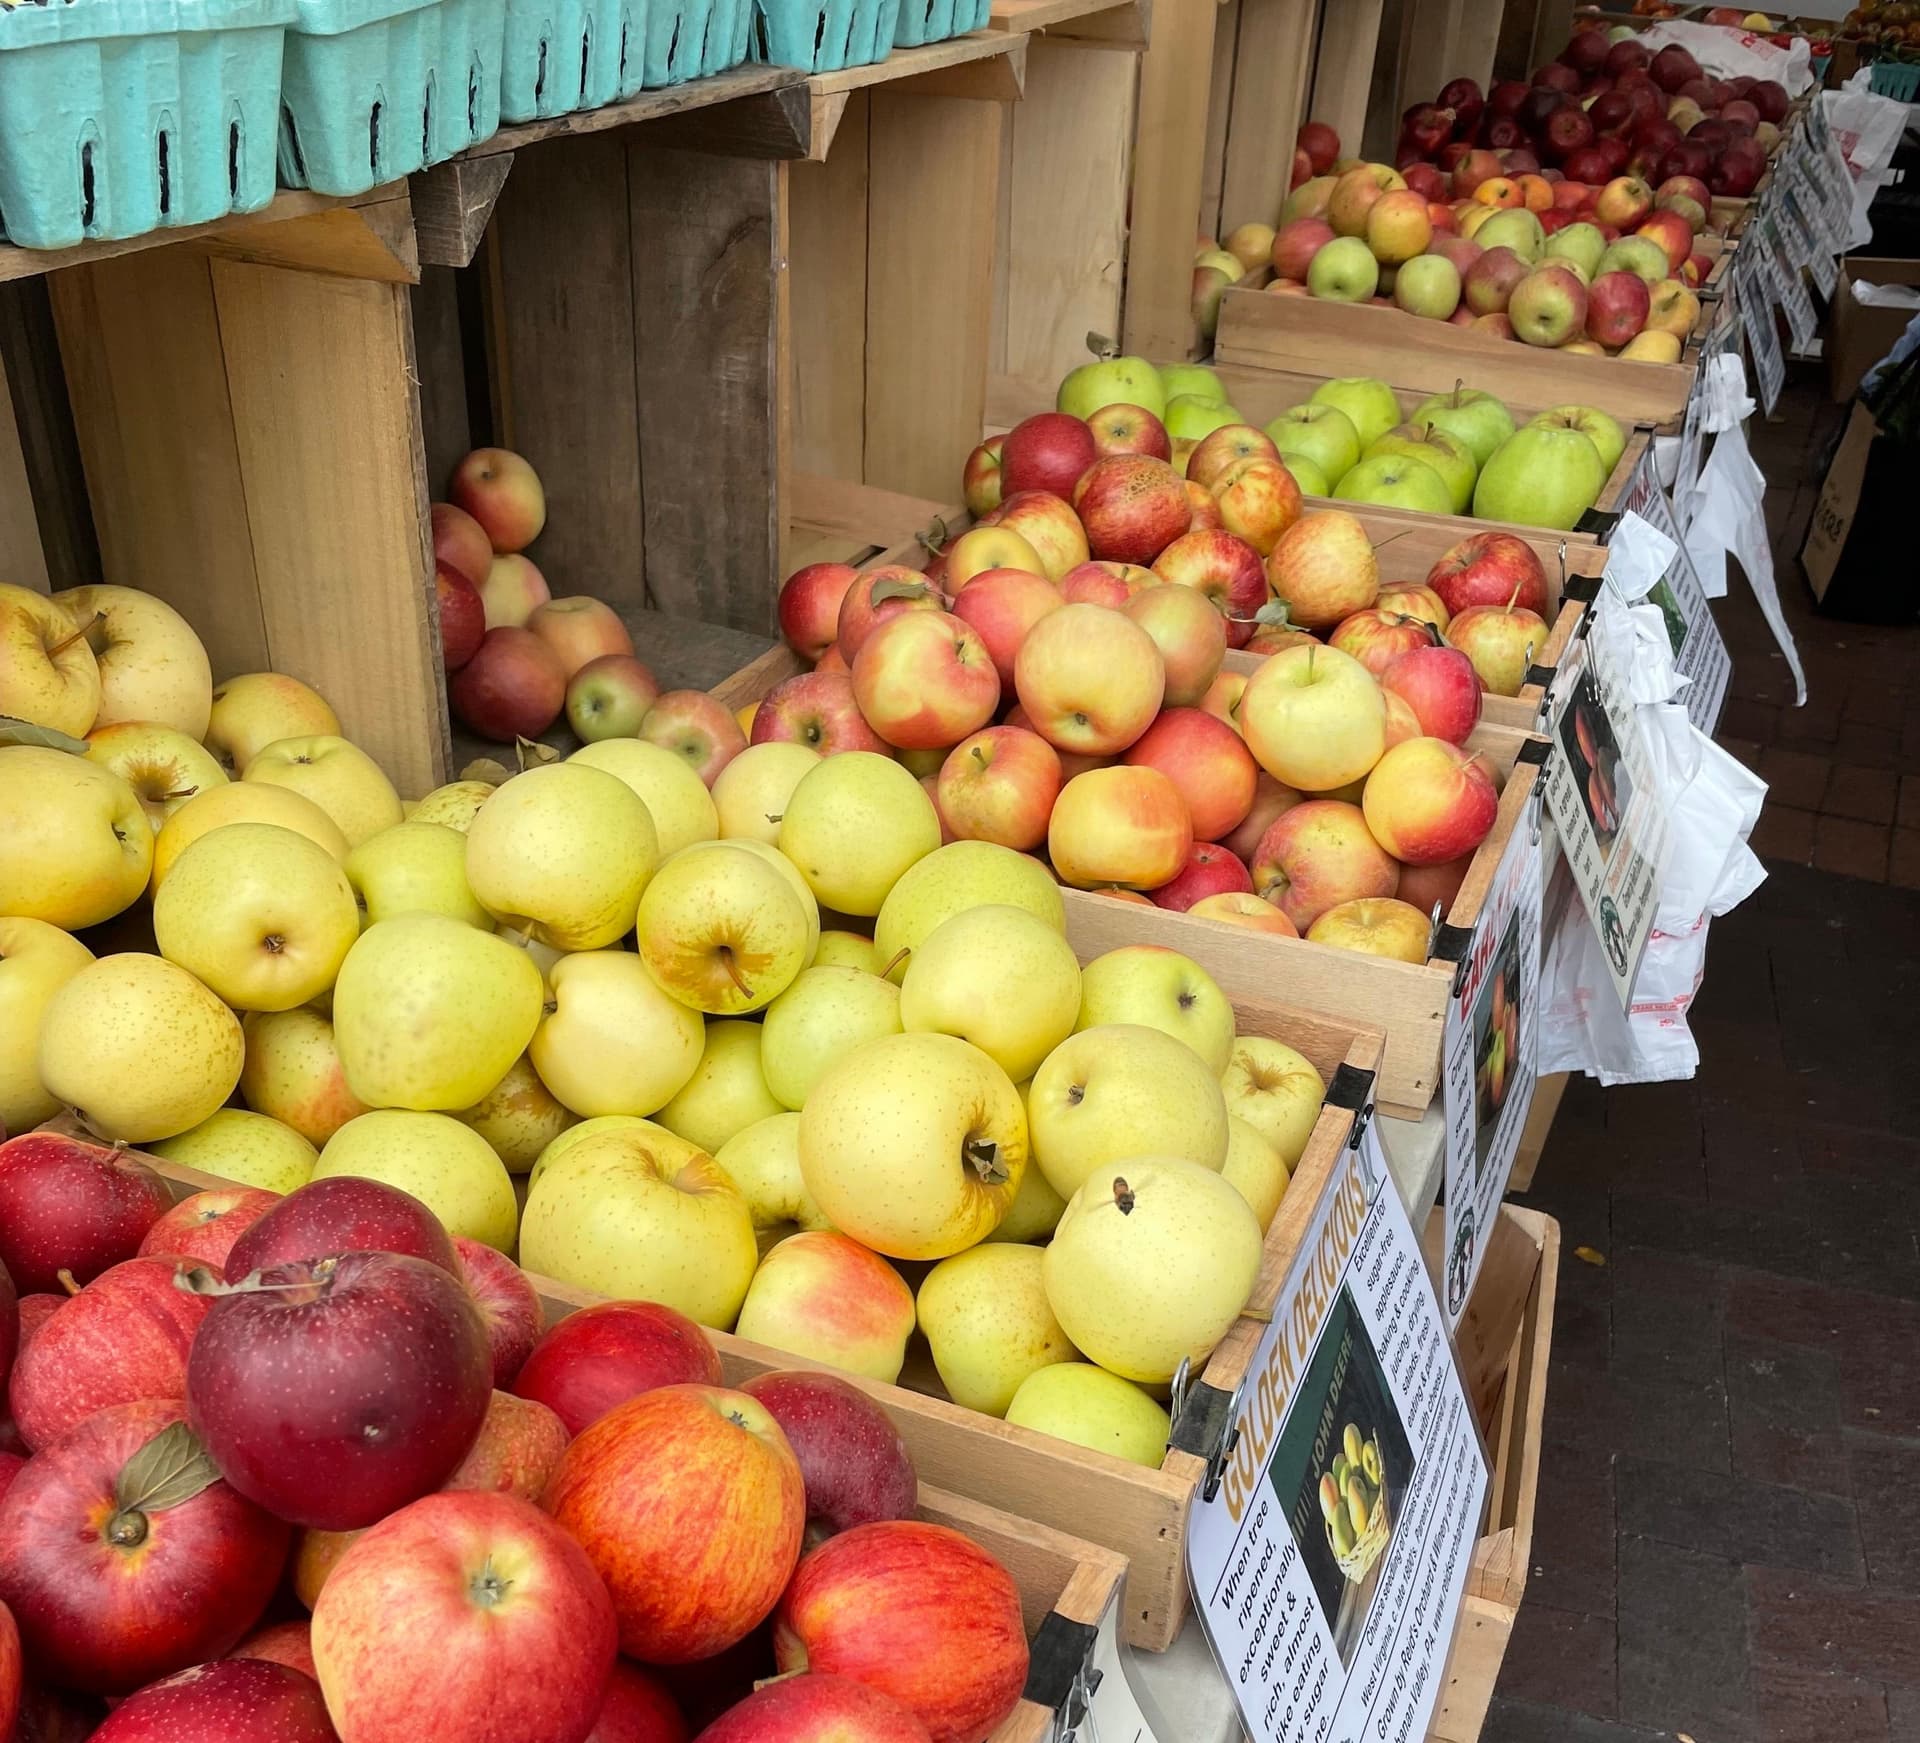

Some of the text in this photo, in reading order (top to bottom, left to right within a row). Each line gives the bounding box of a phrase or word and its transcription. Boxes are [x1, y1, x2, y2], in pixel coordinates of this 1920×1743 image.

[1451, 1029, 1472, 1086] Crunchy
[1458, 1066, 1468, 1102] and
[1455, 1090, 1471, 1139] sweet
[1458, 1128, 1469, 1160] with
[1451, 1137, 1475, 1206] excellent
[1353, 1198, 1387, 1273] Excellent for
[1366, 1228, 1395, 1292] sugar-free
[1375, 1250, 1407, 1322] applesauce,
[1377, 1258, 1421, 1363] baking & cooking,
[1222, 1153, 1366, 1523] GOLDEN DELICIOUS
[1390, 1290, 1426, 1383] juicing, drying,
[1402, 1315, 1431, 1396] salads, fresh
[1313, 1327, 1354, 1478] JOHN DEERE
[1407, 1330, 1441, 1429] eating & pairing
[1417, 1366, 1444, 1441] with cheese
[1413, 1458, 1428, 1499] Golden
[1430, 1463, 1442, 1496] many
[1451, 1474, 1459, 1498] our
[1454, 1444, 1467, 1480] Farm
[1400, 1496, 1417, 1538] Grimes
[1414, 1502, 1428, 1543] Parent
[1426, 1492, 1433, 1508] to
[1446, 1496, 1455, 1517] on
[1221, 1500, 1269, 1611] When tree
[1399, 1532, 1406, 1550] of
[1432, 1511, 1450, 1559] Winery
[1238, 1538, 1276, 1630] ripened,
[1383, 1550, 1403, 1601] seedling
[1430, 1553, 1437, 1573] &
[1240, 1538, 1296, 1684] exceptionally
[1391, 1610, 1398, 1623] c.
[1394, 1583, 1405, 1610] late
[1414, 1563, 1435, 1627] Orchard
[1261, 1591, 1297, 1683] sweet &
[1366, 1597, 1385, 1647] Chance
[1264, 1596, 1315, 1732] rich, almost
[1373, 1623, 1395, 1674] Virginia,
[1400, 1623, 1419, 1673] Reid's
[1275, 1632, 1321, 1743] like eating
[1303, 1657, 1329, 1726] sugar
[1360, 1667, 1377, 1708] West
[1394, 1666, 1407, 1692] by
[1394, 1703, 1415, 1743] hanan
[1410, 1657, 1431, 1705] Valley,
[1314, 1715, 1330, 1743] ne.
[1376, 1686, 1400, 1741] Grown
